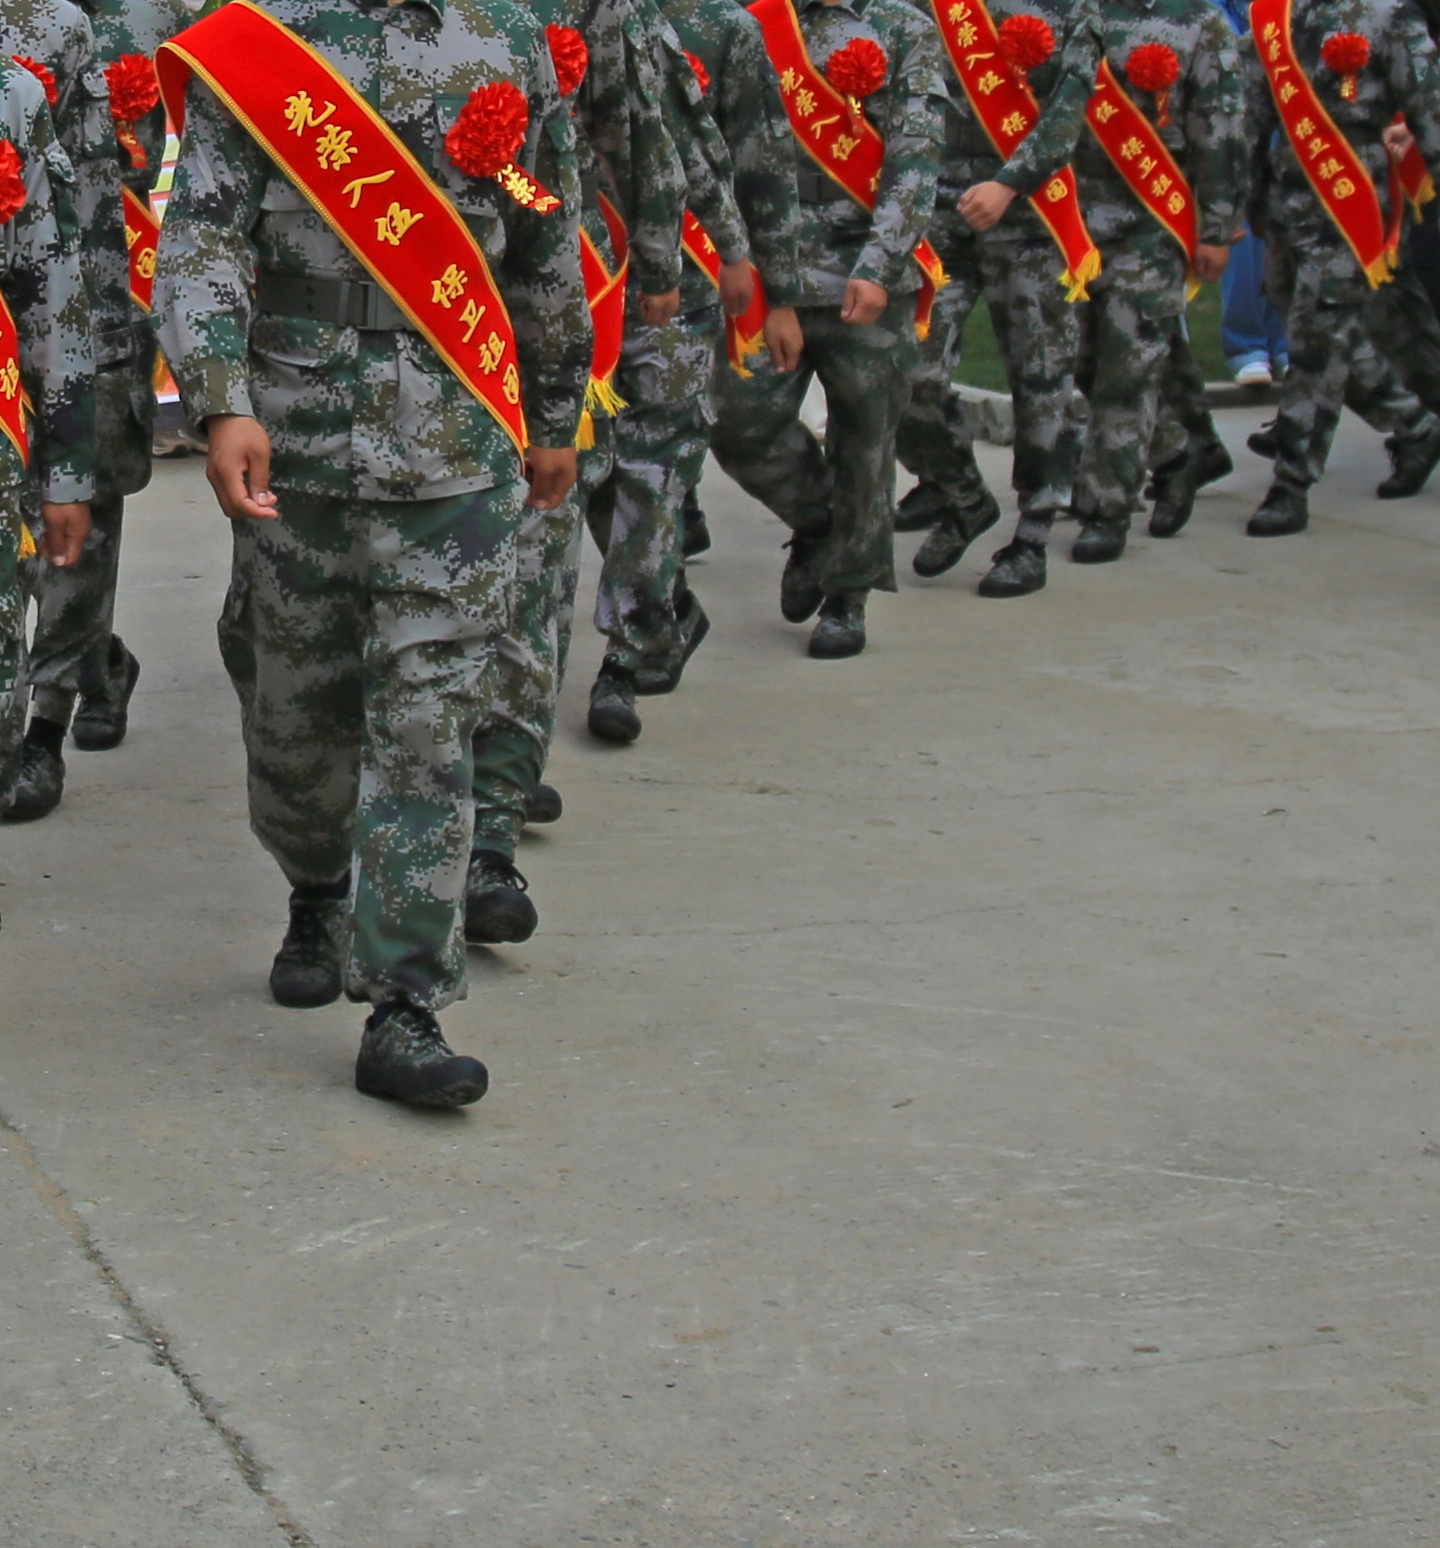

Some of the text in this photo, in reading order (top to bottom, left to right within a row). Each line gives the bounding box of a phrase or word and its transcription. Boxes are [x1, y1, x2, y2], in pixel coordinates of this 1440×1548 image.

[948, 2, 1005, 95] 光荣入伍
[781, 68, 861, 161] 光荣入伍
[1296, 117, 1355, 199] 保卫祖国
[1121, 136, 1185, 214] 保卫祖国
[284, 90, 519, 404] 光荣入伍 保卫祖国
